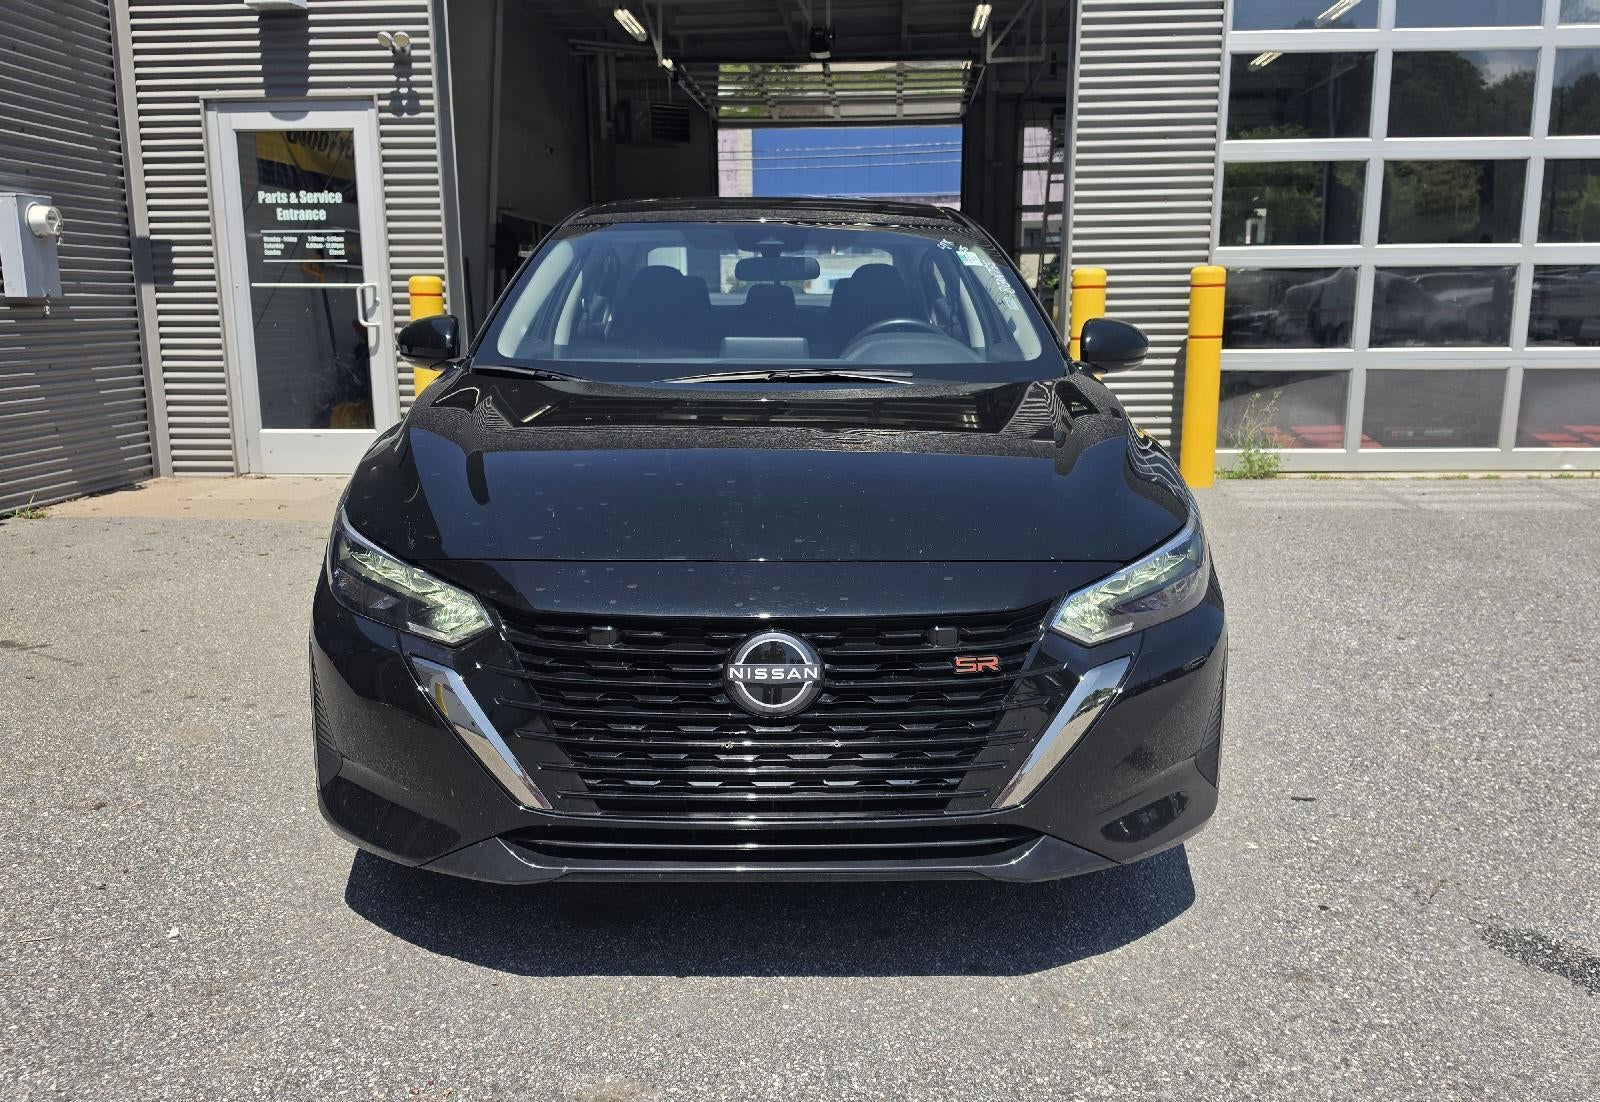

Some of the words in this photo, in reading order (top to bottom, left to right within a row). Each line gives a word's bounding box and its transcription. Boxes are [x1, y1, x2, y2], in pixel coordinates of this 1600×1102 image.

[258, 190, 288, 204] Parts
[289, 193, 298, 204] &
[299, 190, 343, 204] Service
[276, 208, 326, 221] Entrance
[954, 655, 1001, 673] SR
[729, 666, 818, 680] NISSAN
